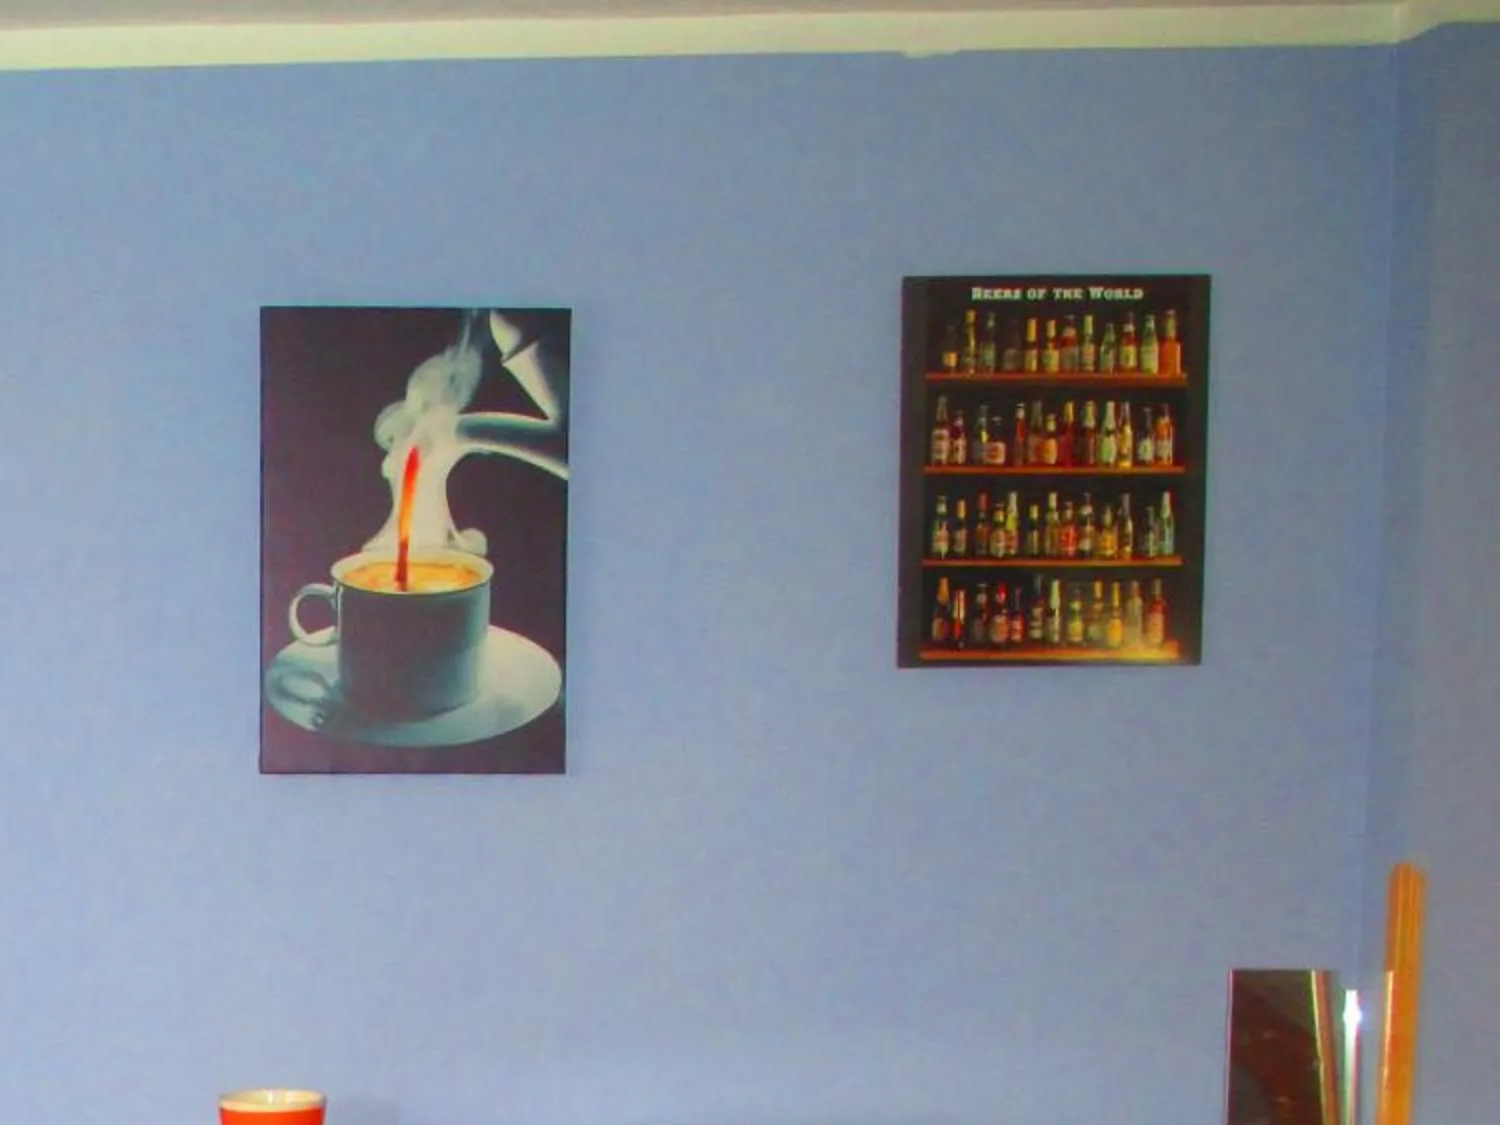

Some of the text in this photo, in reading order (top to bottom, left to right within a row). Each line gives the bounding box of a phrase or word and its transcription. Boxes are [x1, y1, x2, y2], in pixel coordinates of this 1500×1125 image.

[1027, 287, 1048, 300] OF
[1052, 286, 1083, 300] THE
[1089, 286, 1144, 300] WORLD
